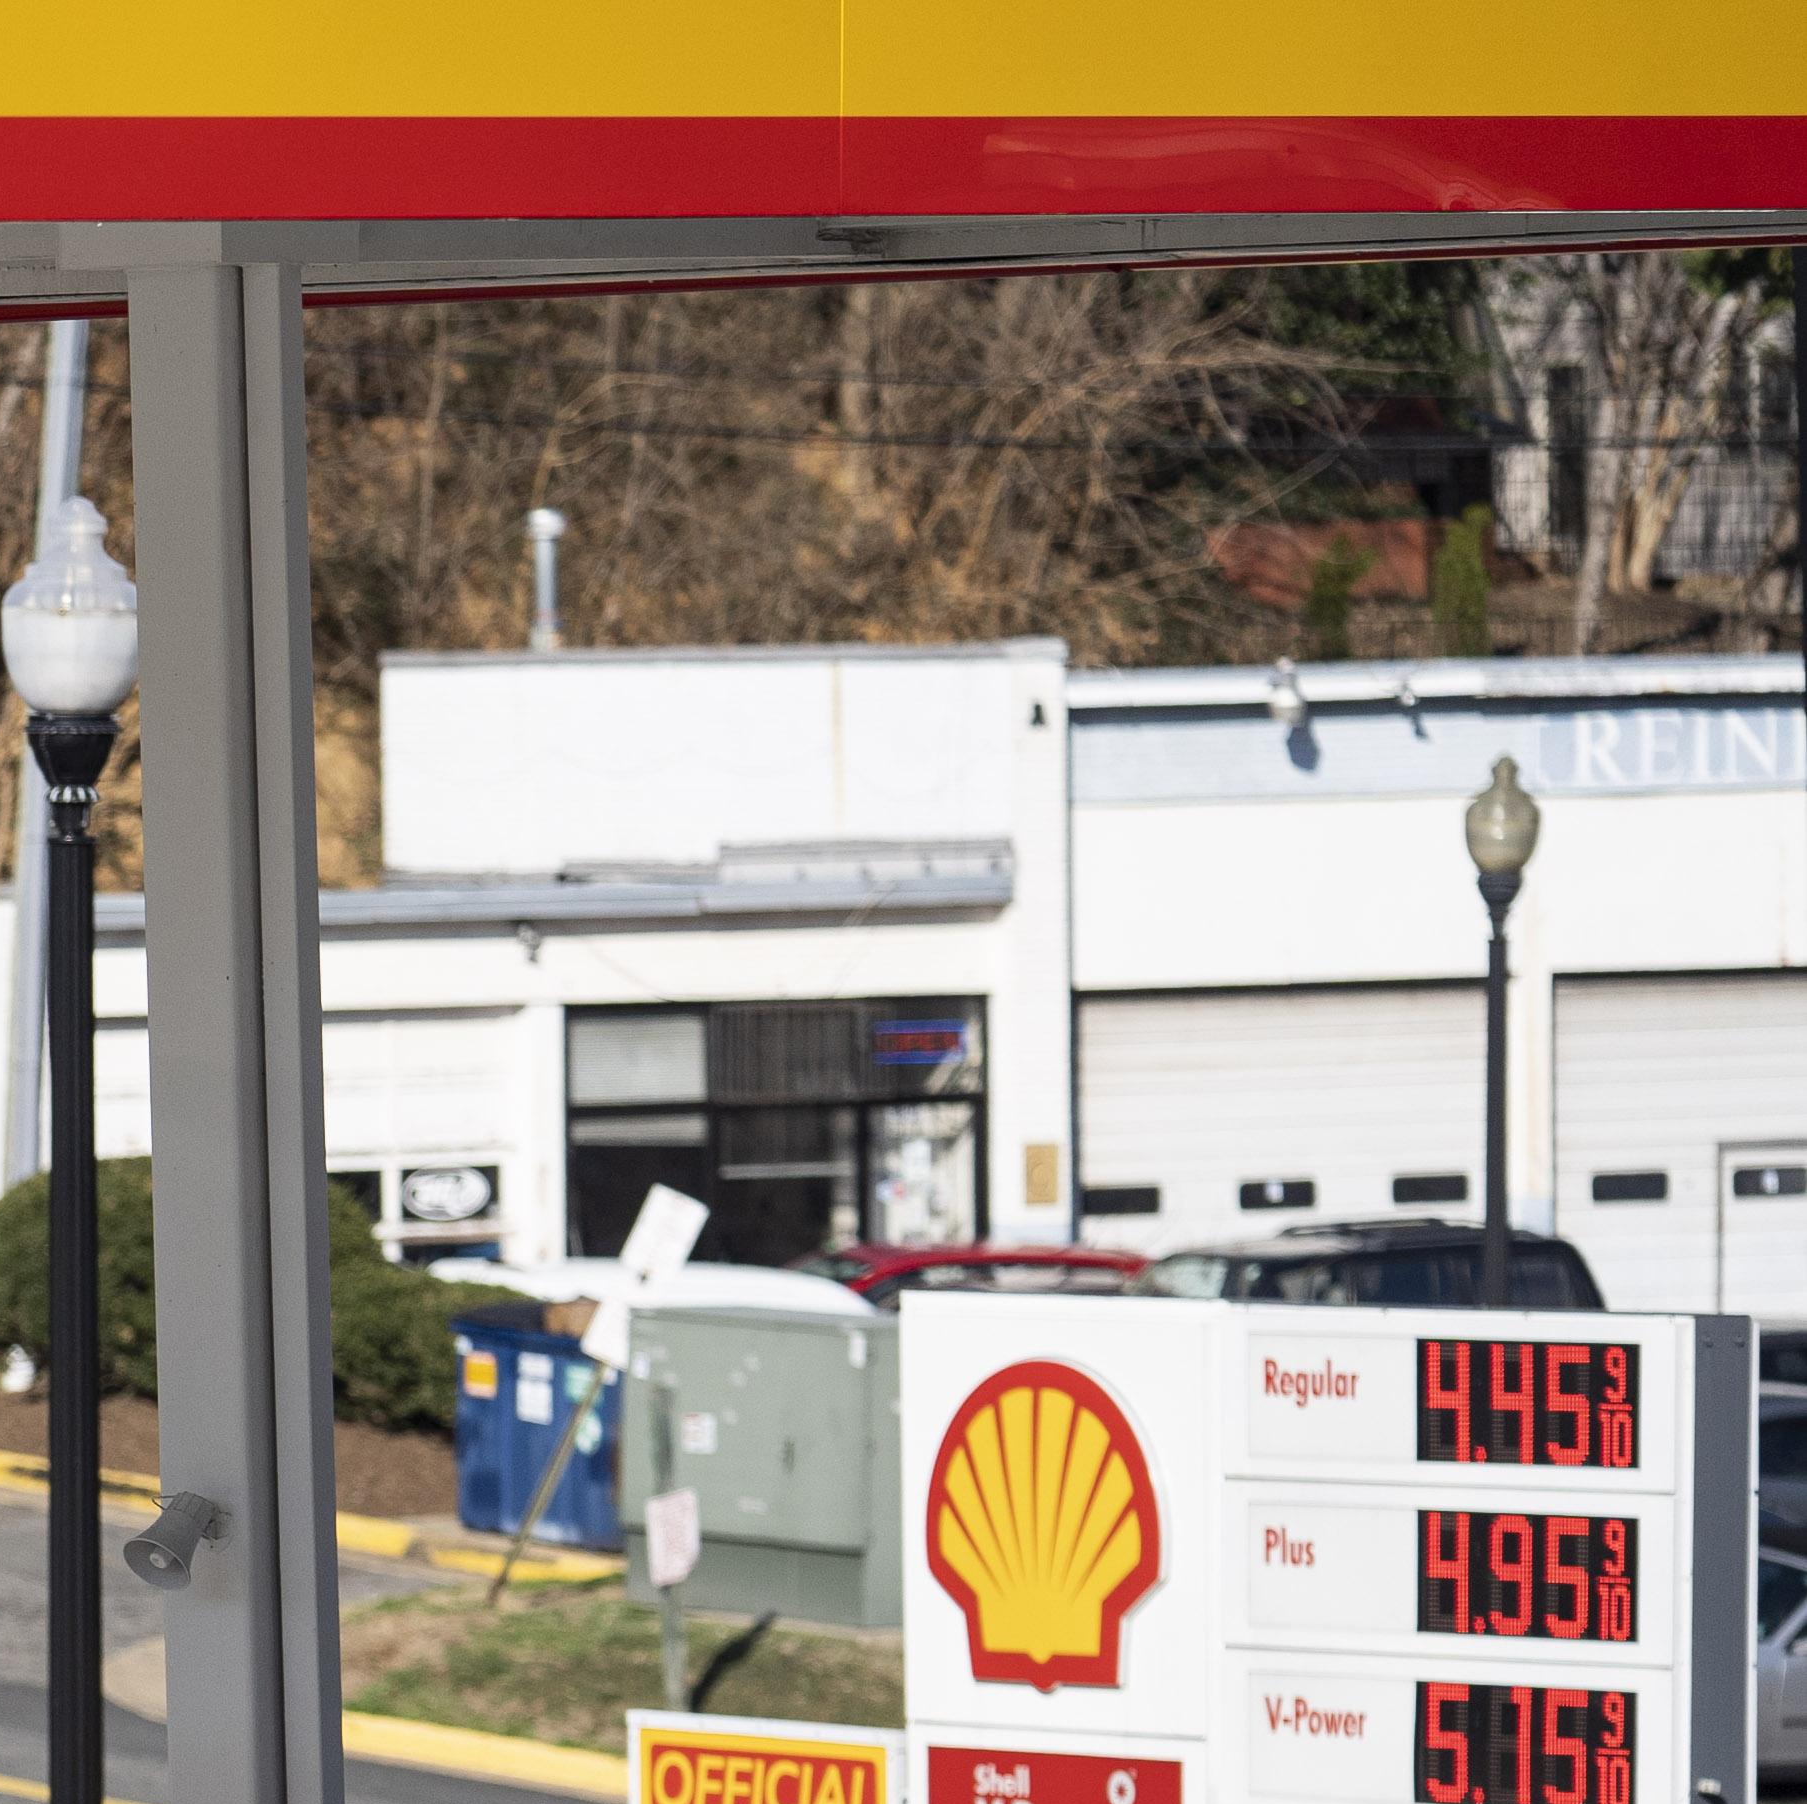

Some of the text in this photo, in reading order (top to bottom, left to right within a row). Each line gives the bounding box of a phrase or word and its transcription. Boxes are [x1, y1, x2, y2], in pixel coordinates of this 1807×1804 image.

[1264, 1358, 1359, 1408] Regular
[1426, 1341, 1591, 1467] 4.45
[1264, 1526, 1316, 1568] Plus
[1425, 1511, 1590, 1639] 4.95
[1264, 1695, 1367, 1739] V-Power
[974, 1762, 1031, 1799] Shell
